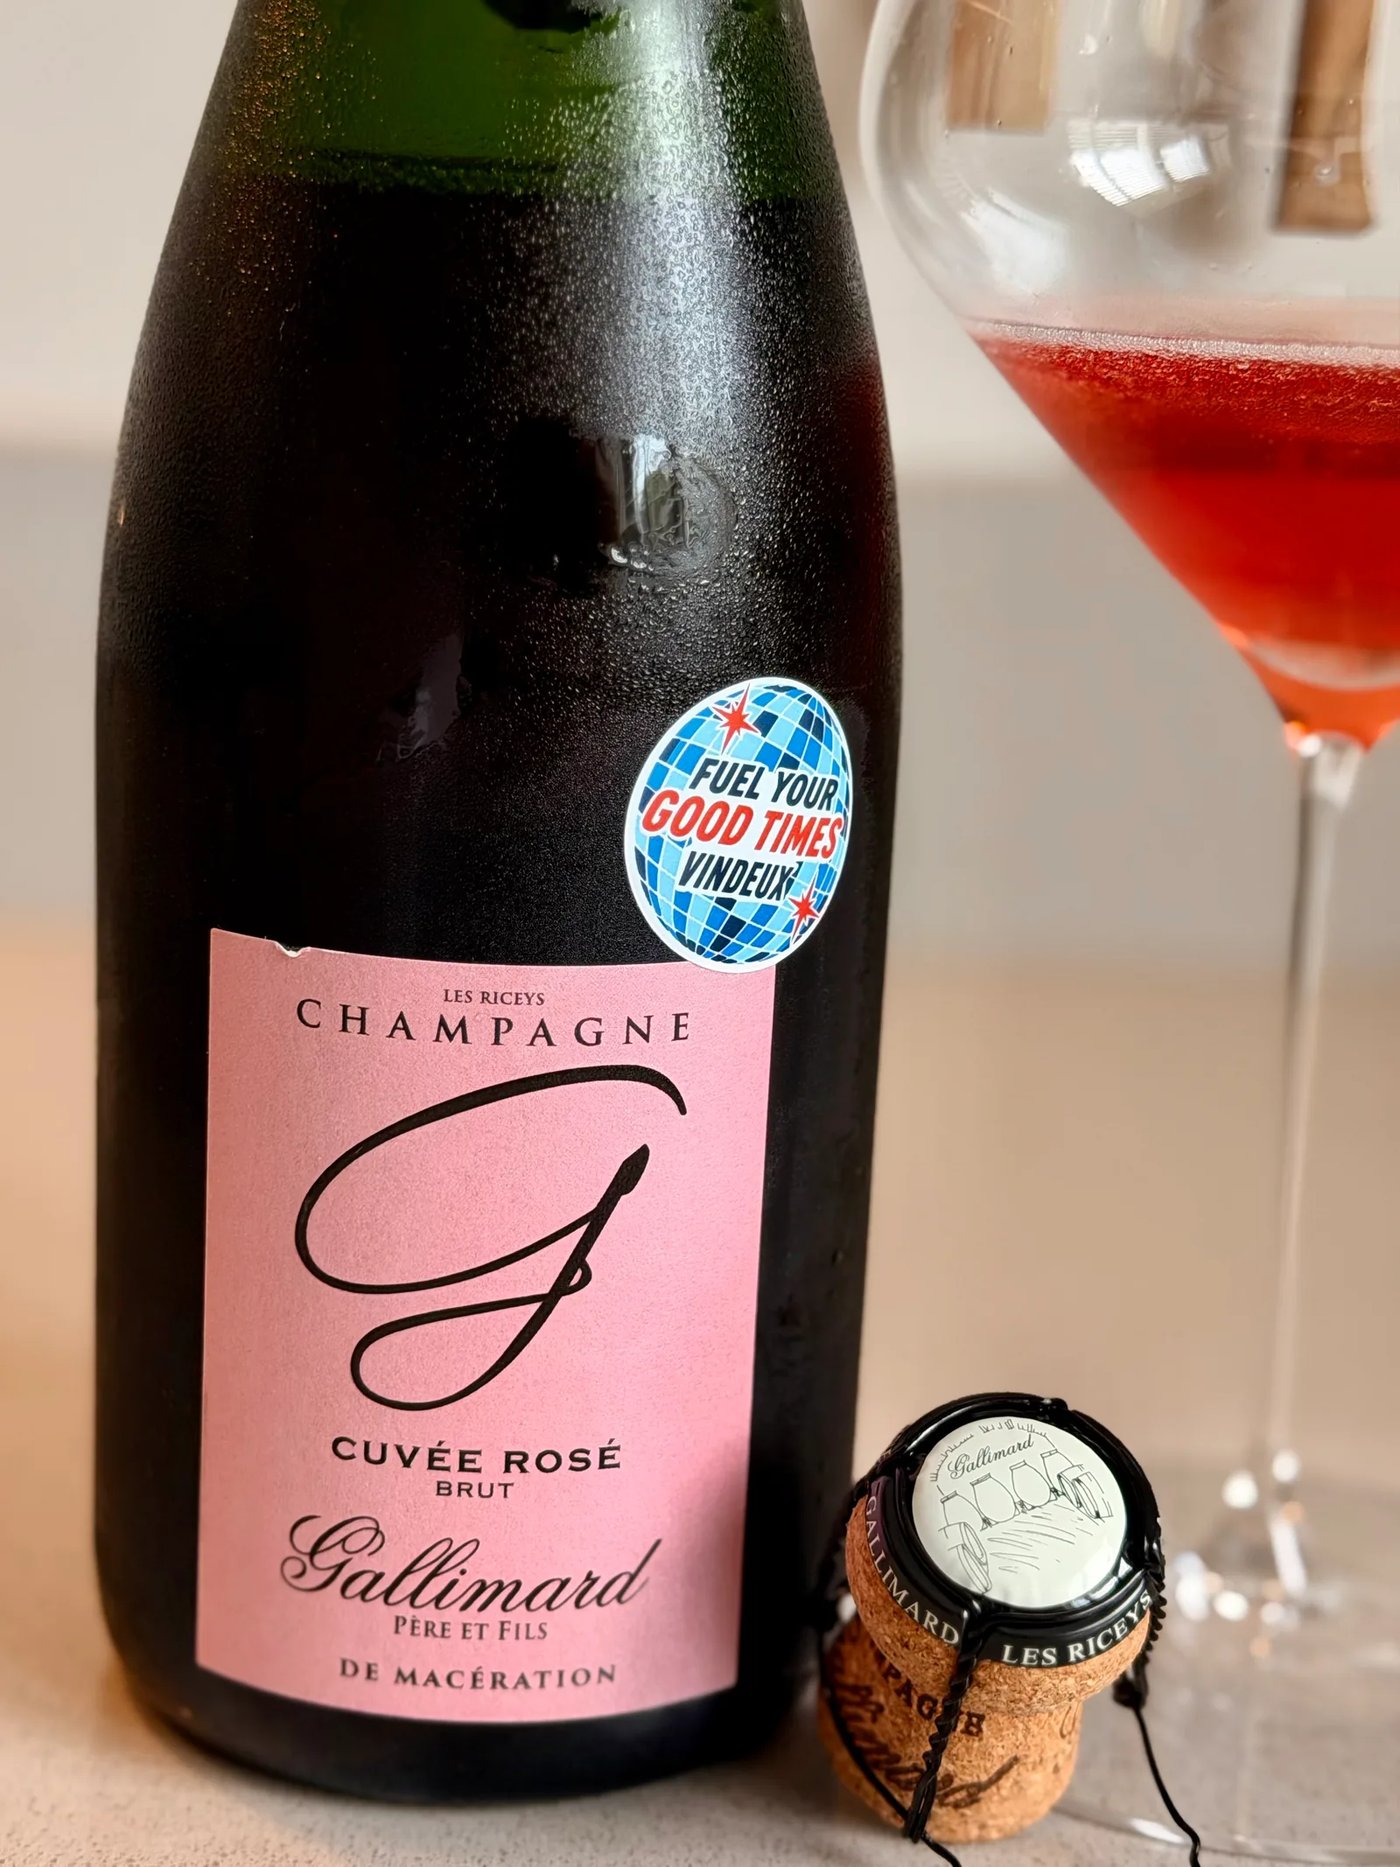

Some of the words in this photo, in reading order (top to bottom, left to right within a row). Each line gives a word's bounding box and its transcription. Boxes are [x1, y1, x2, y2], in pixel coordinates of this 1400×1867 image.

[689, 758, 766, 800] FUEL
[771, 771, 838, 811] YOUR
[642, 789, 754, 846] GOOD
[754, 810, 843, 859] TIMES
[678, 851, 793, 901] VINDEUX
[443, 989, 473, 1004] LES
[480, 990, 546, 1006] RICEYS
[296, 998, 691, 1047] CHAMPAGNE
[331, 1436, 483, 1474] CUVÉE
[503, 1438, 622, 1475] ROSÉ
[947, 1433, 1034, 1480] Gallimard
[435, 1480, 515, 1499] BRUT
[280, 1514, 662, 1613] Gallimard
[865, 1496, 960, 1645] GALLIMARD
[1002, 1644, 1058, 1666] LES
[1067, 1589, 1153, 1663] RICEYS
[339, 1657, 379, 1682] DE
[393, 1663, 617, 1691] MACÉRATION
